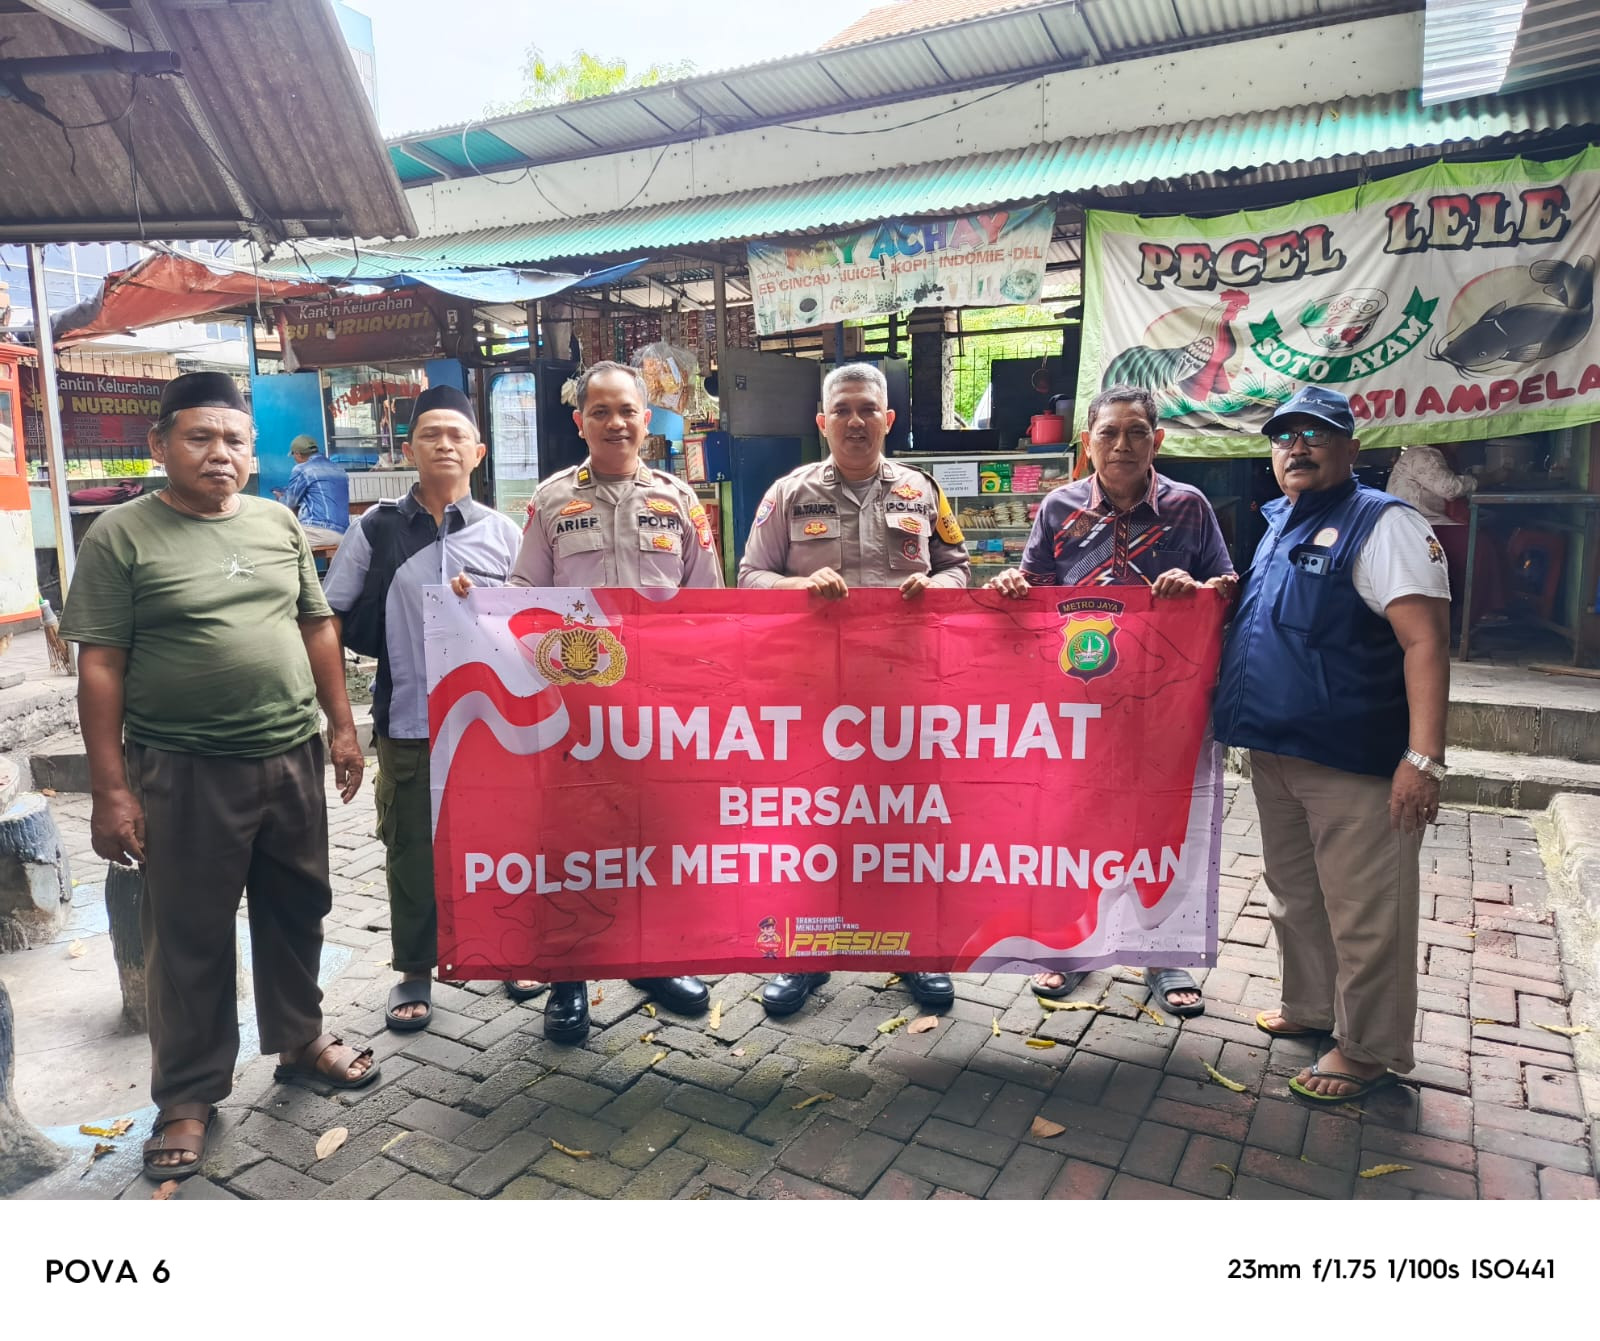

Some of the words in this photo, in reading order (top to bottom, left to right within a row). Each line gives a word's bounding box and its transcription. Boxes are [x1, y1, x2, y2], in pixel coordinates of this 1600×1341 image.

[869, 211, 1009, 257] ACHAY
[1137, 224, 1347, 291] PECEL
[1383, 184, 1571, 257] LELE
[758, 281, 777, 296] ES
[779, 272, 831, 293] CINCAU
[840, 266, 881, 283] JUICE
[890, 258, 927, 274] KOPI
[939, 248, 1005, 268] INDOMIE
[300, 303, 340, 320] Kantn
[1256, 336, 1330, 381] SOTO
[1347, 315, 1428, 378] AYAM
[56, 374, 95, 392] antin
[97, 377, 160, 396] Kelurahan
[1414, 364, 1600, 416] AMPELA
[556, 517, 599, 533] ARIEF
[638, 514, 681, 531] POLRI
[886, 501, 927, 515] POLRI
[1063, 601, 1095, 612] METRO
[1097, 601, 1118, 612] JAYA
[570, 705, 802, 761] JUMAT
[822, 702, 1101, 761] CURHAT
[719, 784, 952, 826] BERSAMA
[464, 845, 657, 895] POLSEK
[672, 843, 838, 886] METRO
[852, 843, 1187, 889] PENJARINGAN
[789, 931, 911, 951] PRESISI
